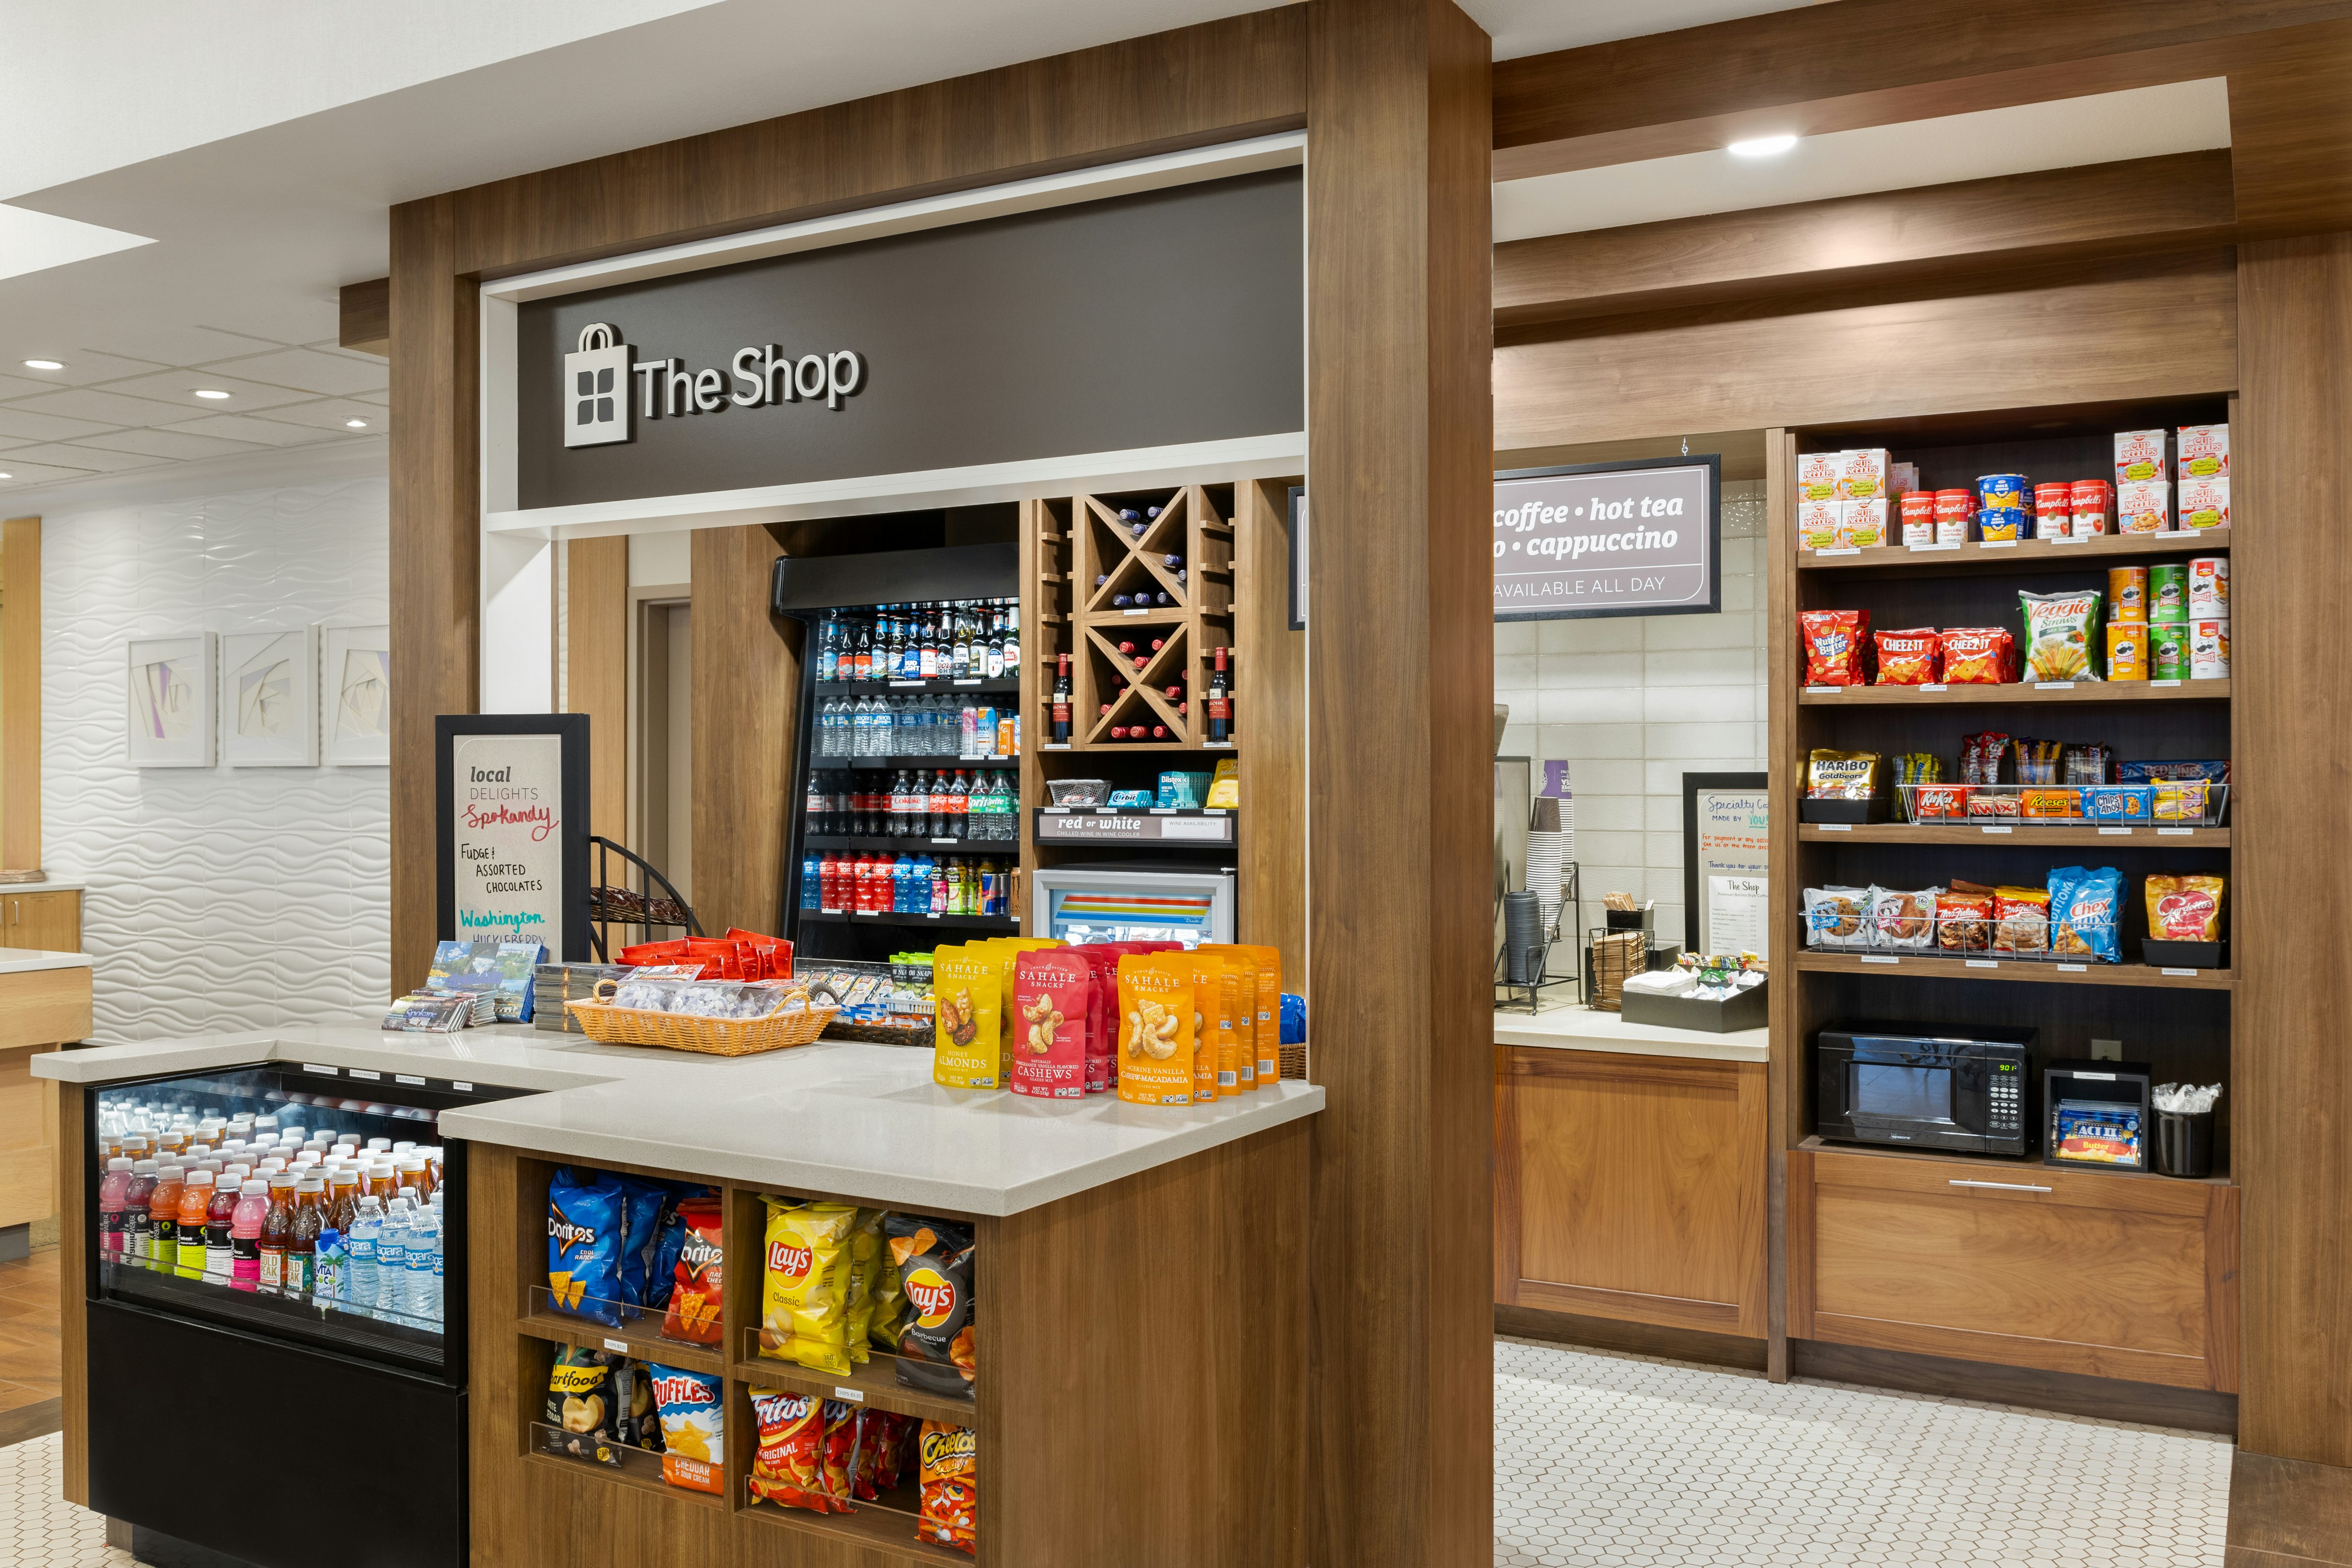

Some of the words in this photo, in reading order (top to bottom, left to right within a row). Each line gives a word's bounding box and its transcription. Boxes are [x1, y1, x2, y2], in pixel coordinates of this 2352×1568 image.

[633, 358, 726, 418] The
[732, 343, 863, 410] Shop
[2130, 441, 2150, 451] CUP
[2193, 436, 2215, 446] CUP
[2122, 447, 2158, 458] NOODLES
[2185, 443, 2222, 453] NOODLES
[1853, 459, 1872, 468] CUP
[1804, 469, 1835, 479] NOODLES
[1846, 465, 1878, 475] NOODLES
[2132, 492, 2153, 502] CUP
[2185, 495, 2223, 505] NOODLES
[2194, 489, 2215, 499] CUP
[1936, 503, 1967, 515] Campbell's
[2036, 498, 2069, 509] Campbell's
[2124, 498, 2161, 509] NOODLES
[1494, 501, 1568, 532] coffee
[1590, 498, 1635, 522] hot
[1640, 497, 1683, 517] tea
[1855, 509, 1874, 517] CUP
[1902, 505, 1932, 517] Campbell's
[1804, 517, 1836, 526] NOODLES
[1847, 515, 1880, 524] NOODLES
[1526, 525, 1678, 560] cappuccino
[1494, 580, 1584, 597] AVAILABLE
[1592, 578, 1623, 593] ALL
[1631, 576, 1665, 592] DAY
[2121, 598, 2141, 609] PRINGLES
[2160, 596, 2181, 606] PRINGLES
[2192, 592, 2211, 603] PRINGLES
[2028, 602, 2092, 623] Veggie
[2040, 616, 2077, 628] Straws
[1814, 633, 1844, 649] Nutter
[1819, 640, 1848, 655] Butter
[2115, 655, 2135, 664] PRINGLES
[2159, 655, 2179, 665] PRINGLES
[2195, 653, 2215, 663] PRINGLES
[1816, 760, 1870, 771] HARIBO
[471, 767, 511, 782] local
[1161, 776, 1182, 784] Blistex
[470, 788, 538, 800] DELIGHTS
[1111, 792, 1136, 803] Orbit
[1709, 797, 1754, 814] Specialty
[2030, 795, 2069, 808] Reese's
[2097, 794, 2120, 808] Chips
[1969, 802, 2017, 815] Twix
[2158, 806, 2181, 815] Newtons
[1058, 816, 1082, 828] red
[1100, 817, 1141, 829] white
[1748, 814, 1768, 825] YOU!
[477, 864, 525, 877] ASSORTED
[487, 880, 542, 894] CHOCOLATES
[1727, 880, 1740, 890] The
[1743, 881, 1759, 894] Shop
[2071, 898, 2113, 917] Chex
[461, 909, 545, 933] Washington
[940, 963, 988, 975] SAHALE
[1020, 971, 1076, 983] SAHALE
[1125, 975, 1180, 987] SAHALE
[405, 1009, 437, 1019] Spokane
[939, 1056, 987, 1068] ALMONDS
[1018, 1066, 1071, 1079] CASHEWS
[1154, 1065, 1184, 1075] VANILLA
[1121, 1070, 1188, 1083] CASHEW-MACADAMIA
[2078, 1126, 2101, 1136] ACT
[2104, 1126, 2117, 1136] II
[2083, 1141, 2109, 1150] Butter
[549, 1217, 595, 1243] Doritos
[261, 1255, 278, 1266] GOLD
[770, 1241, 810, 1277] Lay's
[261, 1265, 277, 1276] PEAK
[316, 1284, 333, 1295] Coconut
[773, 1291, 800, 1307] Classic
[911, 1328, 946, 1343] Barbecue
[652, 1376, 714, 1412] RUFFLES
[935, 1458, 966, 1473] Crunchy
[681, 1471, 691, 1480] SOUR
[693, 1474, 710, 1484] CREAM
